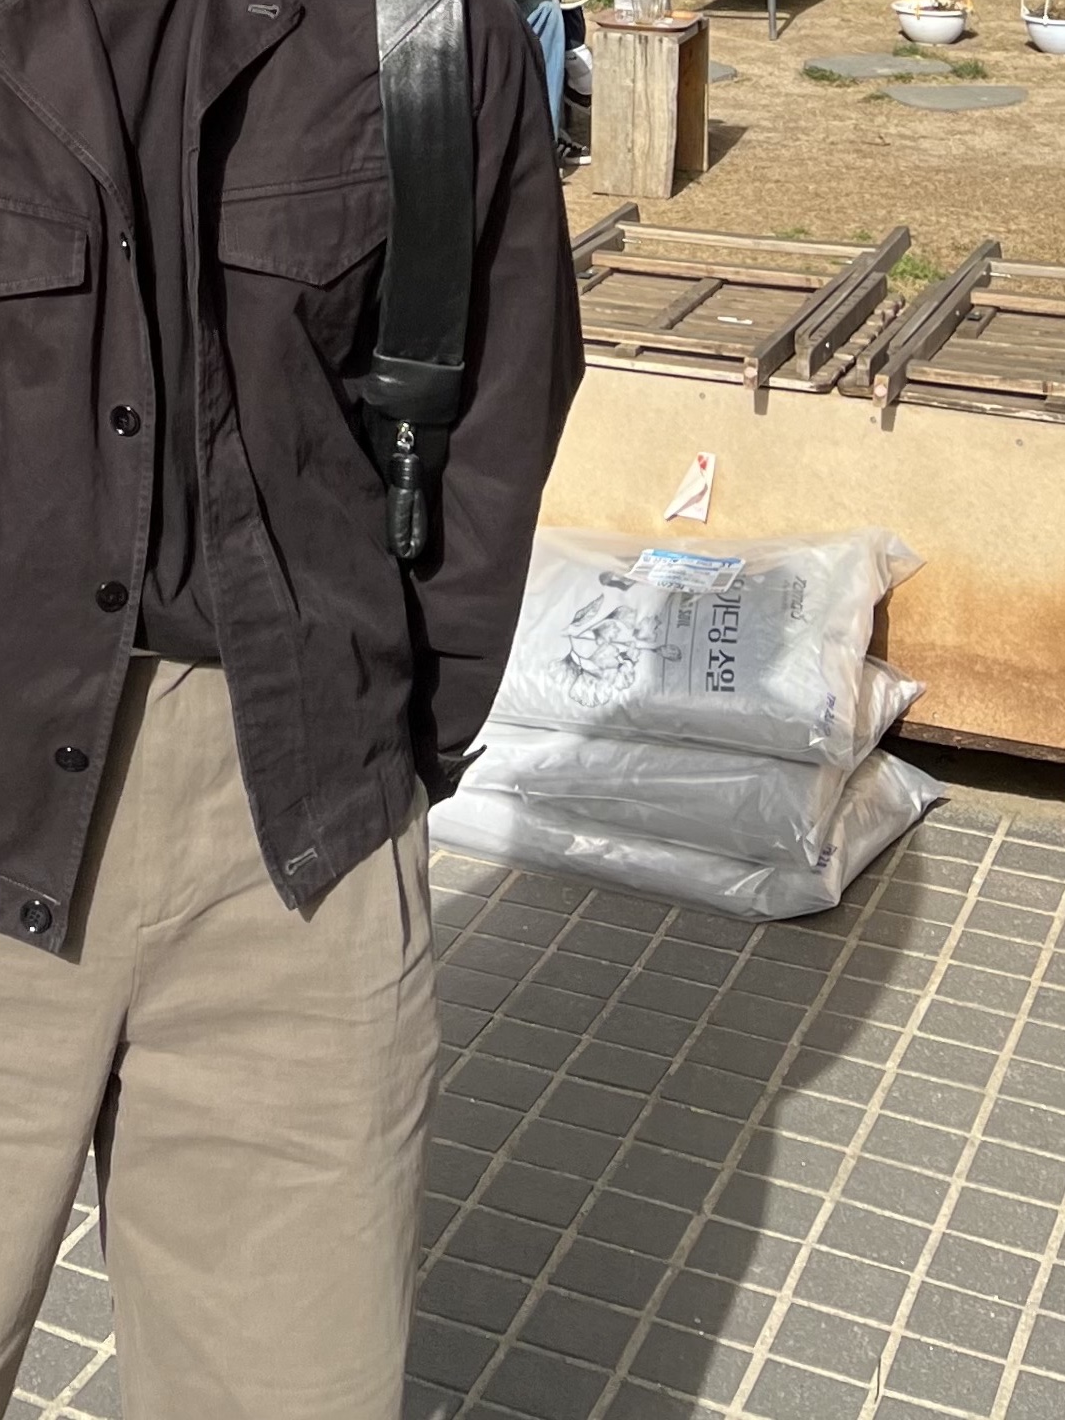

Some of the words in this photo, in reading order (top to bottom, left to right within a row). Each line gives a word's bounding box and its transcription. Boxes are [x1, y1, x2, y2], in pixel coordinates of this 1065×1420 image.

[676, 609, 693, 628] SOIL
[707, 593, 742, 645] 가드닝
[705, 648, 736, 693] 소일
